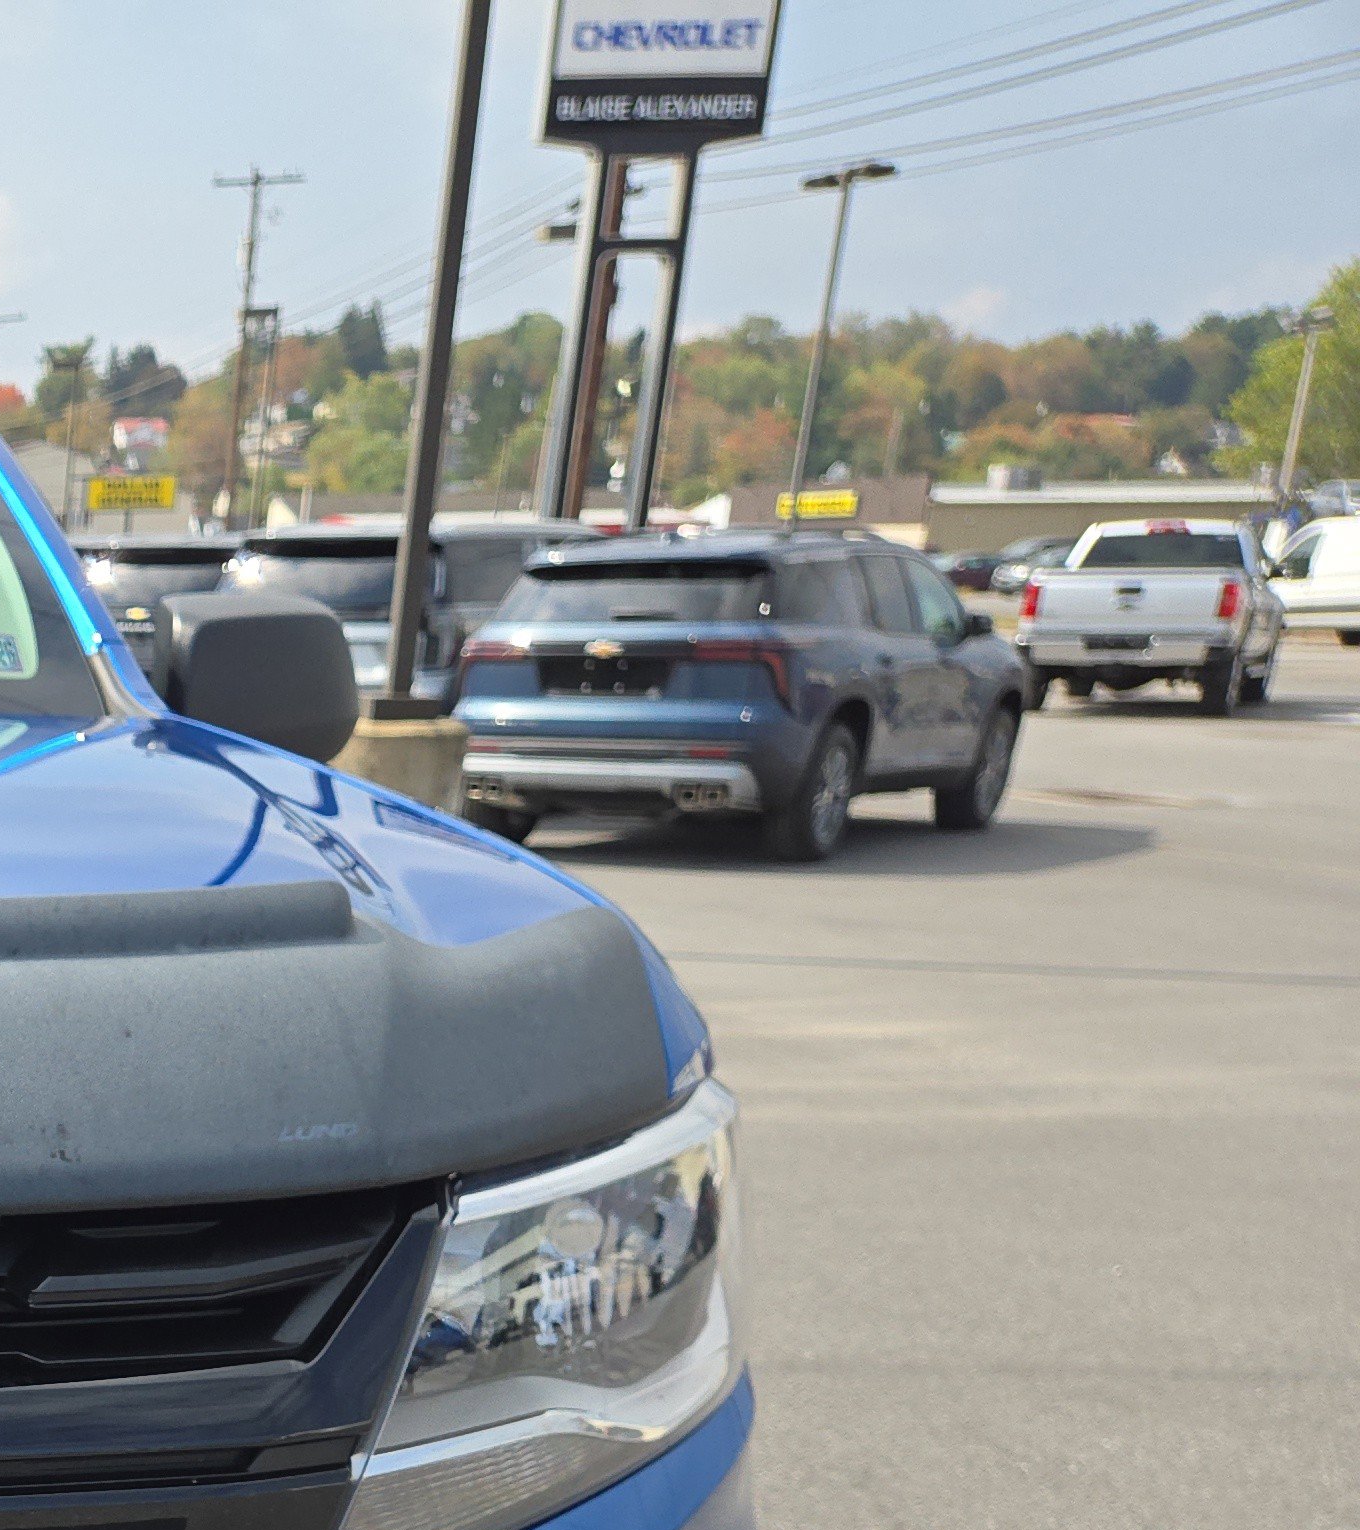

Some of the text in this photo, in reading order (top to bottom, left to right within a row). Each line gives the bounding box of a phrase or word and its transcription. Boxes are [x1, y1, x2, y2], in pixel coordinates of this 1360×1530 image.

[573, 19, 762, 50] CHEVROLET
[632, 95, 757, 120] ALEXANDER
[278, 1122, 359, 1142] LUND
